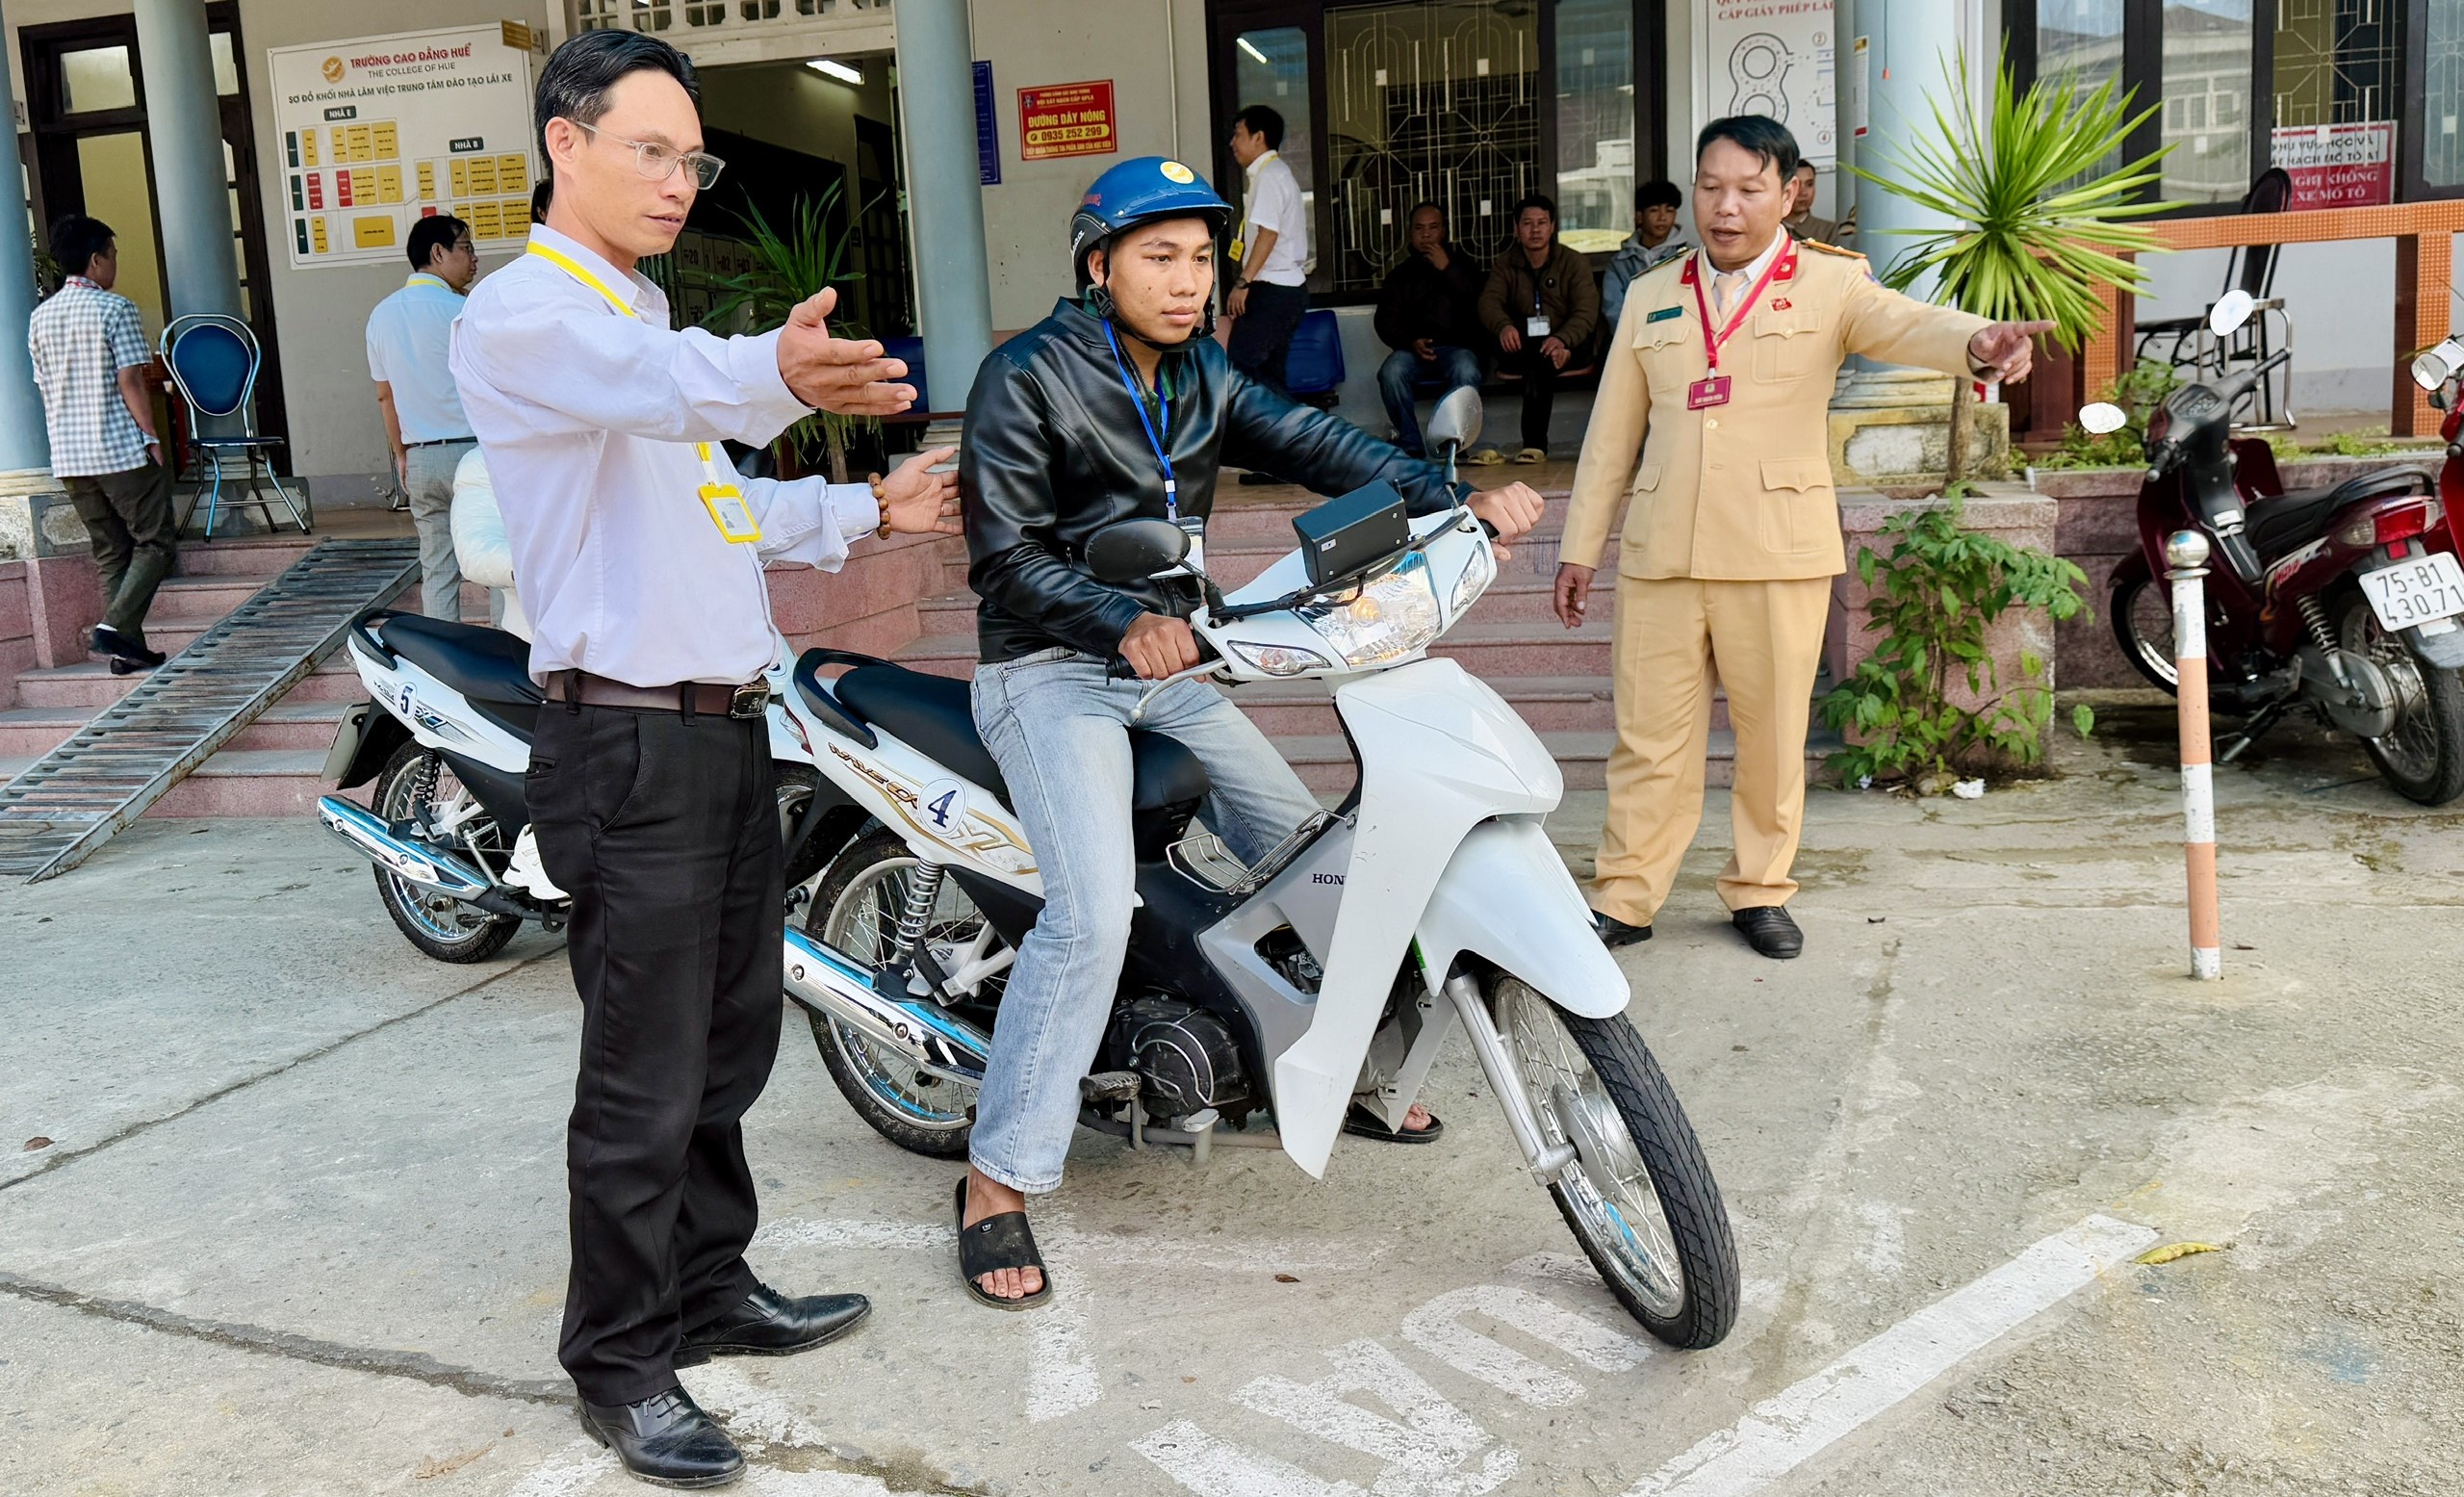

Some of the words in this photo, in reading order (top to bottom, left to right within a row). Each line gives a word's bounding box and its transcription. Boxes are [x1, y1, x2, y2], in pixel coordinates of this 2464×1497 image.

[350, 55, 392, 69] TRƯỜNG
[394, 53, 416, 65] CAO
[419, 45, 448, 62] ĐẲNG
[450, 42, 472, 58] HUẾ
[368, 68, 384, 79] THE
[386, 65, 423, 77] COLLEGE
[425, 64, 436, 73] OF
[438, 62, 455, 71] HUE
[338, 87, 356, 99] NHÀ
[357, 85, 374, 97] LÀM
[376, 83, 396, 97] VIỆC
[398, 81, 425, 93] TRUNG
[426, 78, 445, 90] TÂM
[447, 76, 465, 89] ĐÀO
[468, 76, 484, 89] TẠO
[501, 72, 513, 83] XE
[1028, 114, 1059, 128] ĐƯỜNG
[1061, 111, 1078, 125] DÂY
[1080, 108, 1106, 123] NÓNG
[454, 140, 472, 149] NHÀ
[1041, 131, 1064, 142] 0935
[1065, 128, 1083, 139] 252
[1085, 126, 1102, 137] 299
[2297, 191, 2316, 201] XE
[2347, 185, 2367, 198] TÔ
[2376, 562, 2443, 598] 75-B1
[2383, 584, 2464, 623] 430.71
[399, 685, 414, 714] 5
[927, 789, 958, 828] 4
[1312, 873, 1347, 885] HON
